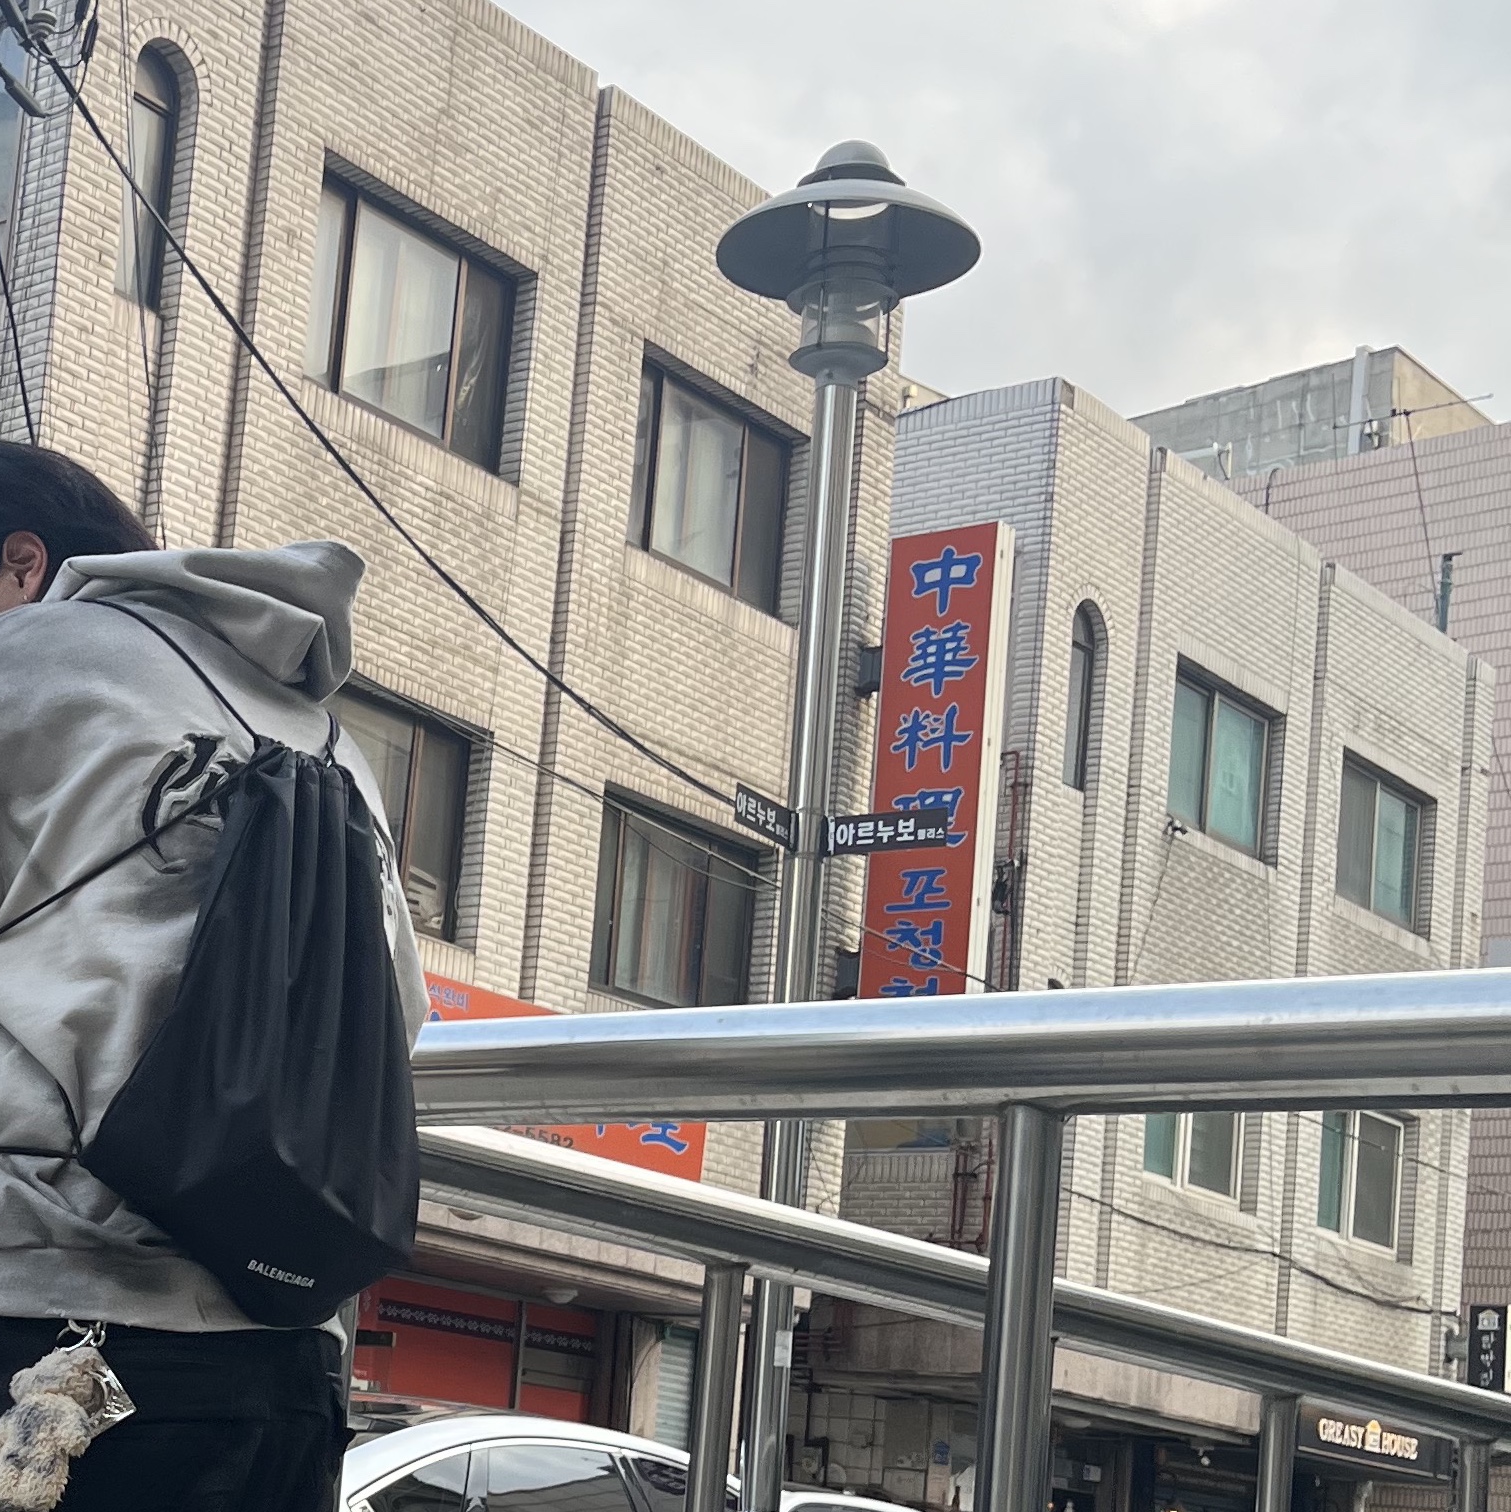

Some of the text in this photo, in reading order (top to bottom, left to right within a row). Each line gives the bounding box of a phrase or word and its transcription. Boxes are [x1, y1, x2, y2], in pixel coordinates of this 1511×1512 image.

[736, 791, 777, 833] 아르누보
[836, 817, 916, 847] 아르누보
[246, 1259, 316, 1289] BALENCIAGA
[1318, 1418, 1419, 1460] GREASY HOUSE
